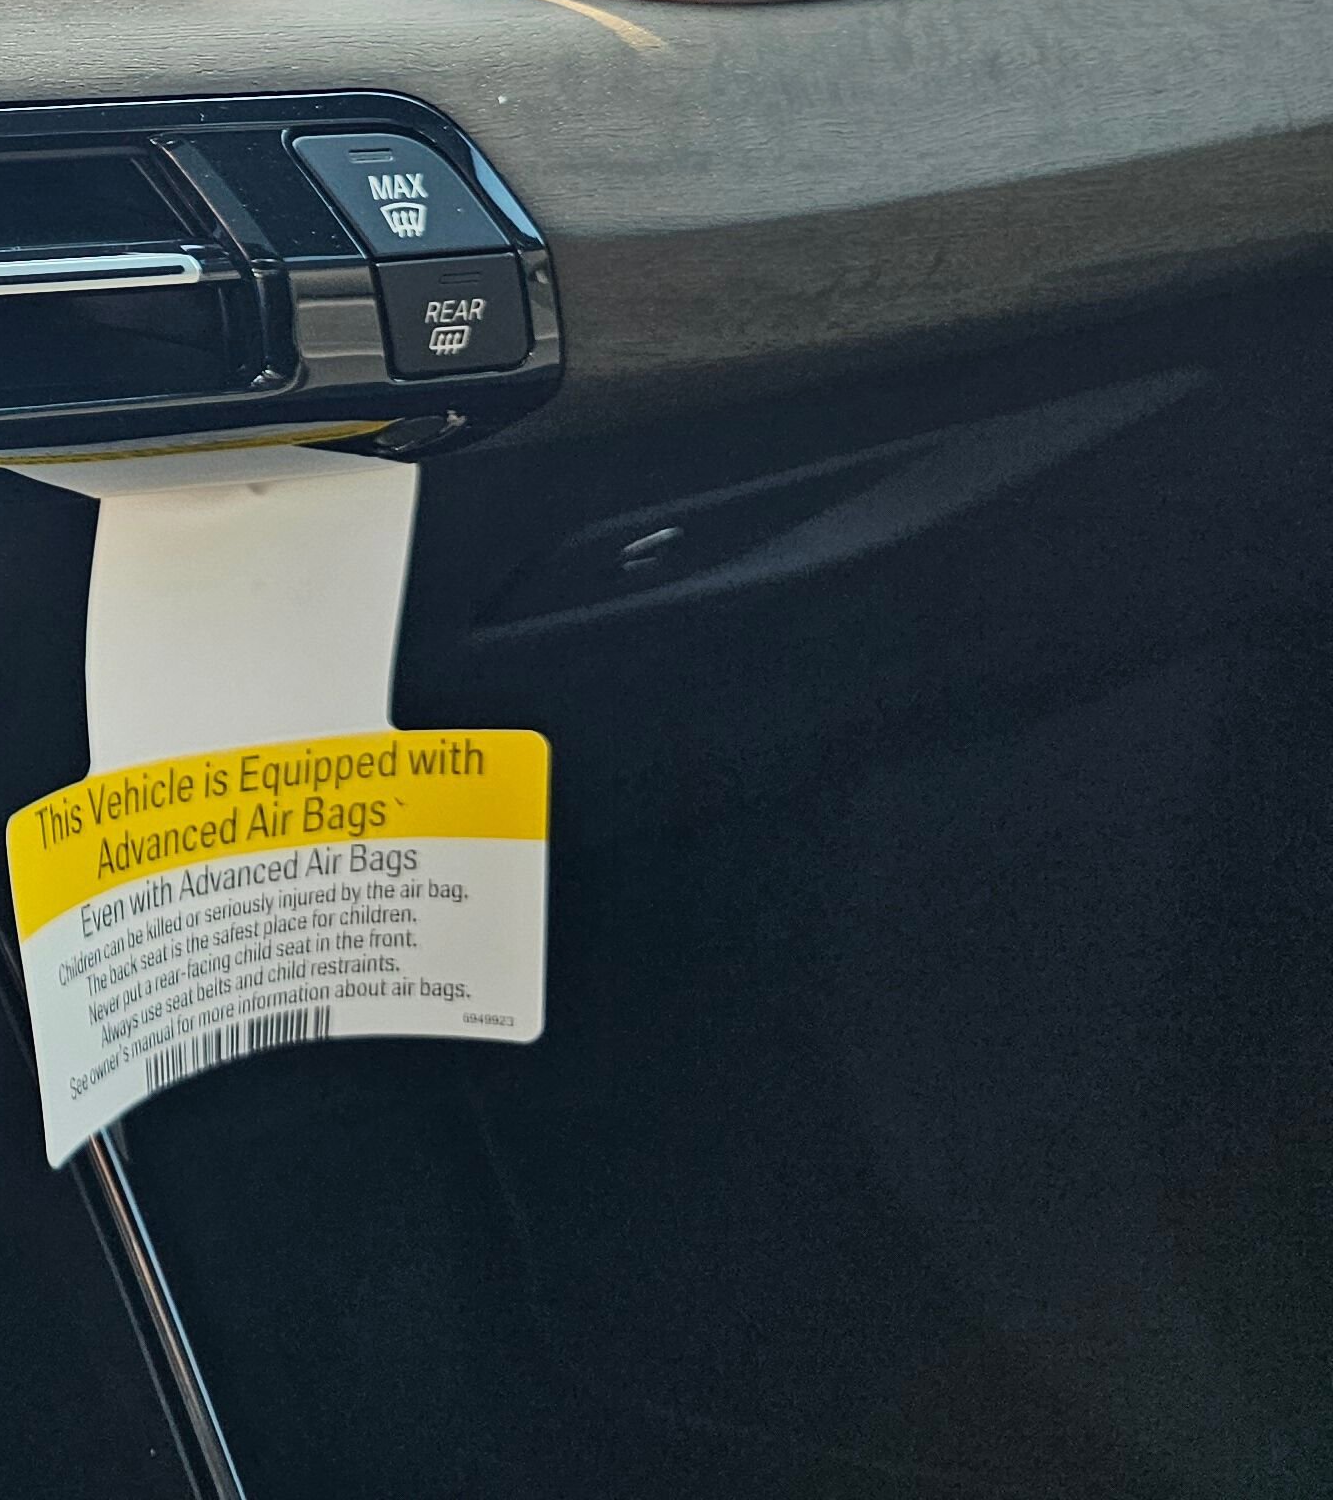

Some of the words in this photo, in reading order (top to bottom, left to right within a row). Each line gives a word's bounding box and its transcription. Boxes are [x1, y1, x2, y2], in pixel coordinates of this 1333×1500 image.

[367, 173, 429, 201] MAX
[425, 298, 485, 324] REAR
[35, 797, 83, 850] This
[87, 767, 194, 825] Vehicle
[205, 761, 228, 798] is
[239, 740, 397, 796] Equipped
[409, 738, 484, 776] with
[98, 806, 238, 879] Advanced
[246, 801, 294, 840] Air
[303, 796, 387, 837] Bags
[59, 949, 101, 986] Children
[103, 936, 125, 959] can
[127, 927, 143, 949] be
[146, 912, 182, 942] killed
[186, 911, 201, 928] or
[204, 892, 274, 924] seriously
[278, 882, 336, 911] injured
[341, 882, 361, 906] by
[366, 881, 395, 900] the
[400, 882, 423, 899] air
[428, 878, 469, 902] bag.
[81, 898, 124, 938] Even
[129, 875, 172, 915] with
[179, 850, 299, 900] Advanced
[305, 846, 342, 878] Air
[350, 843, 418, 878] Bags
[86, 974, 107, 997] The
[109, 956, 138, 985] back
[140, 945, 167, 968] seat
[171, 942, 182, 959] is
[186, 933, 209, 954] the
[212, 921, 259, 947] safest
[263, 914, 308, 936] place
[312, 909, 335, 928] for
[339, 904, 417, 926] children.
[89, 995, 120, 1026] Never
[123, 983, 143, 1006] put
[155, 953, 231, 992] rear-facing
[234, 941, 271, 966] child
[276, 936, 311, 957] seat
[315, 933, 330, 952] in
[336, 930, 364, 950] the
[369, 929, 417, 949] front.
[69, 1074, 88, 1100] See
[132, 1016, 174, 1059] manual
[177, 1014, 196, 1036] for
[198, 1002, 234, 1028] more
[237, 982, 330, 1015] information
[334, 979, 386, 1000] about
[391, 976, 416, 997] air
[419, 977, 471, 1001] bags.
[101, 1014, 139, 1049] Always
[141, 1004, 163, 1024] use
[166, 994, 194, 1014] seat
[197, 976, 232, 1002] belts
[235, 966, 263, 990] and
[267, 959, 306, 984] child
[310, 954, 400, 977] restraints.
